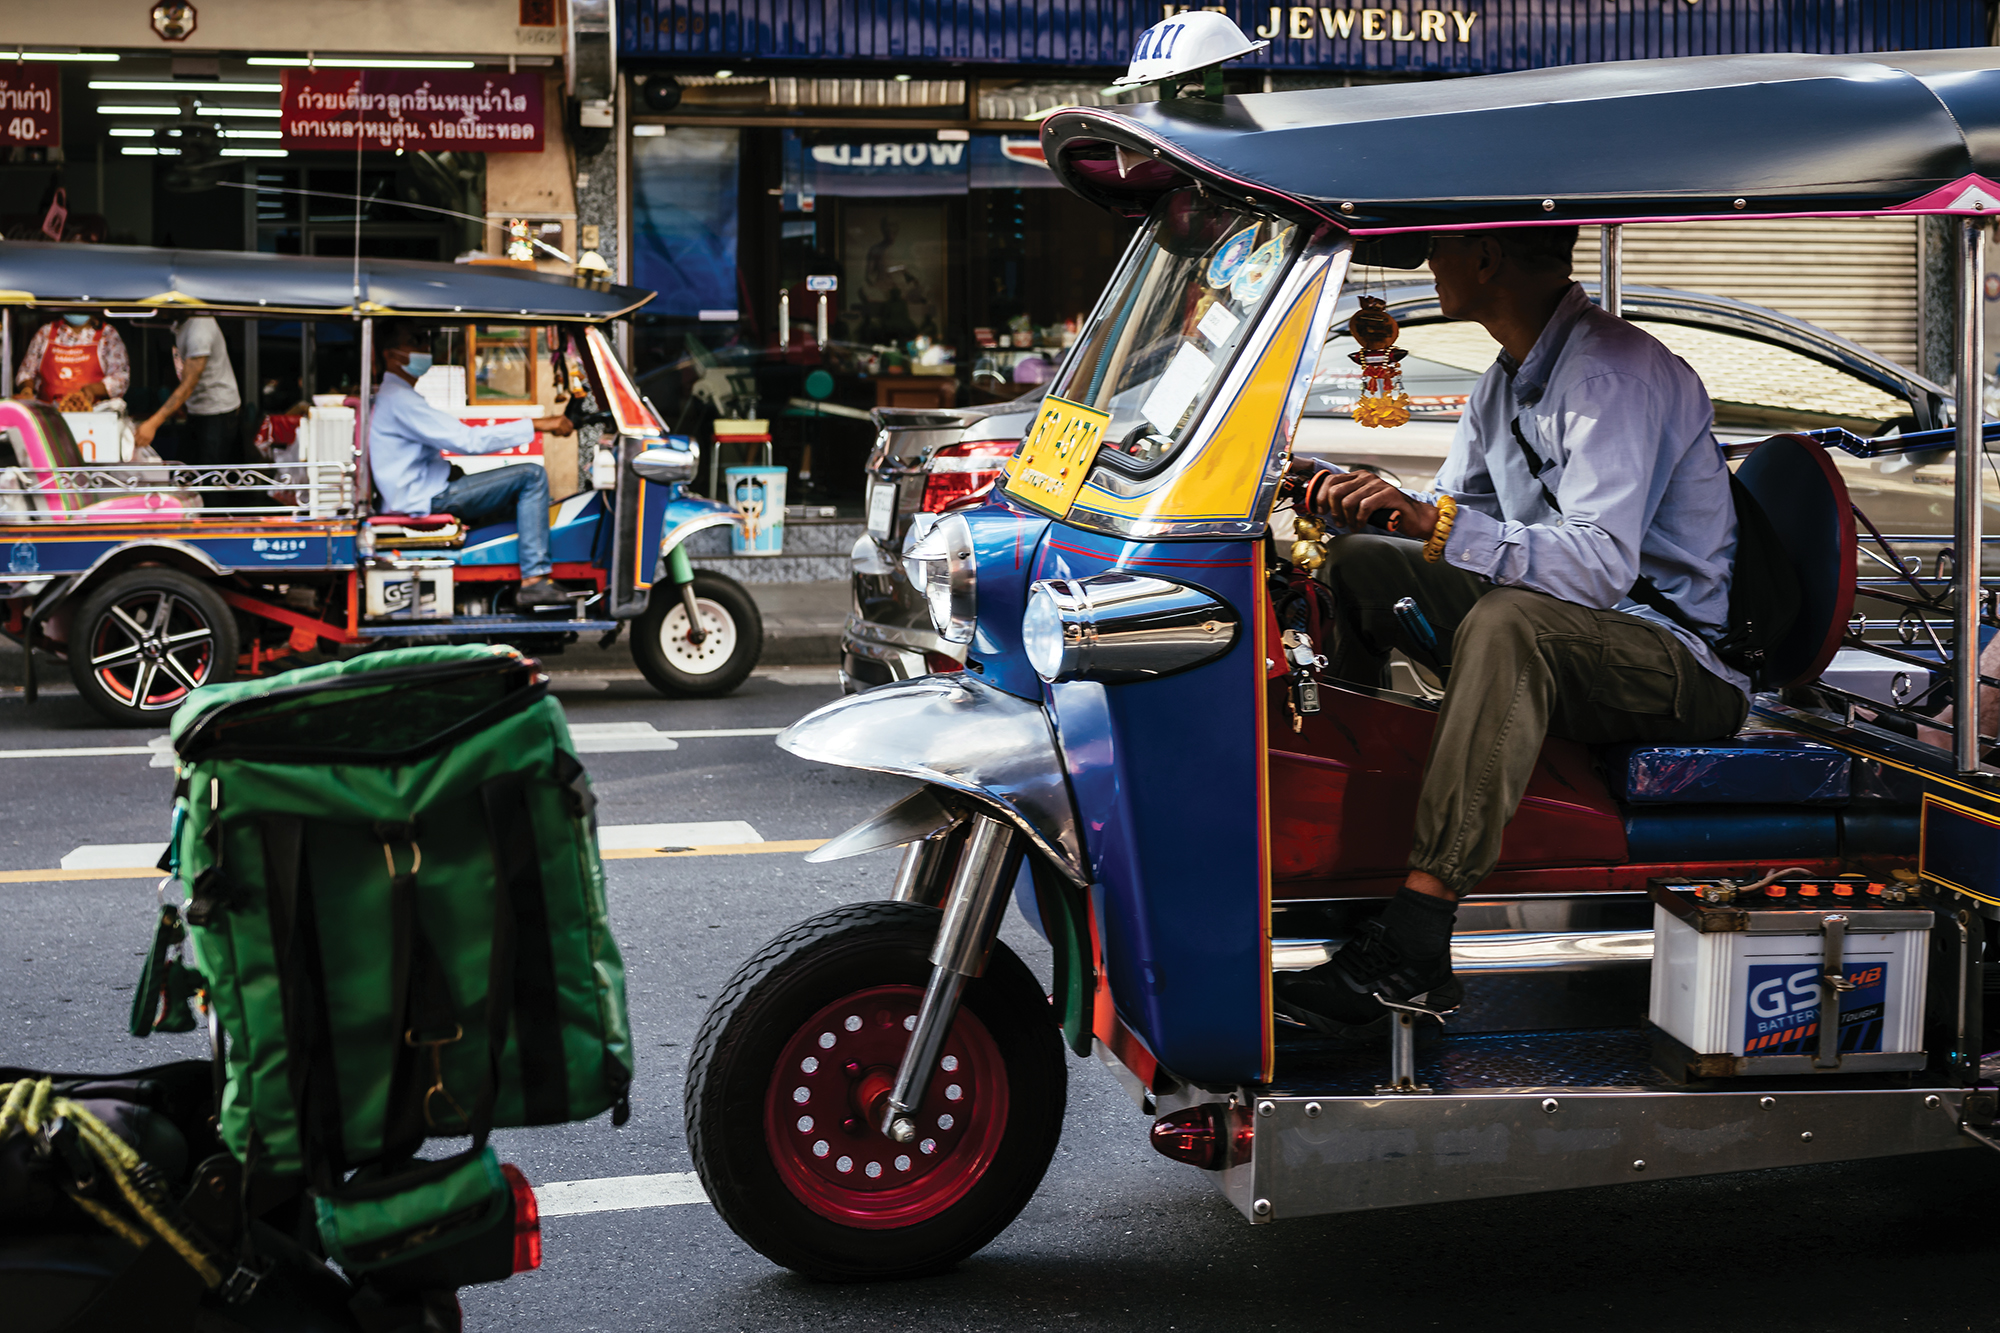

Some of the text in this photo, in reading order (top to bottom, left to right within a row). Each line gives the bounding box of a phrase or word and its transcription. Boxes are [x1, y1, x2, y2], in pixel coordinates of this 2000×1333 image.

[643, 16, 704, 34] 1460
[1257, 6, 1478, 43] JEWELRY
[8, 116, 49, 141] 40.-
[1750, 968, 1822, 1018] GS
[1841, 1007, 1879, 1023] TOUGH
